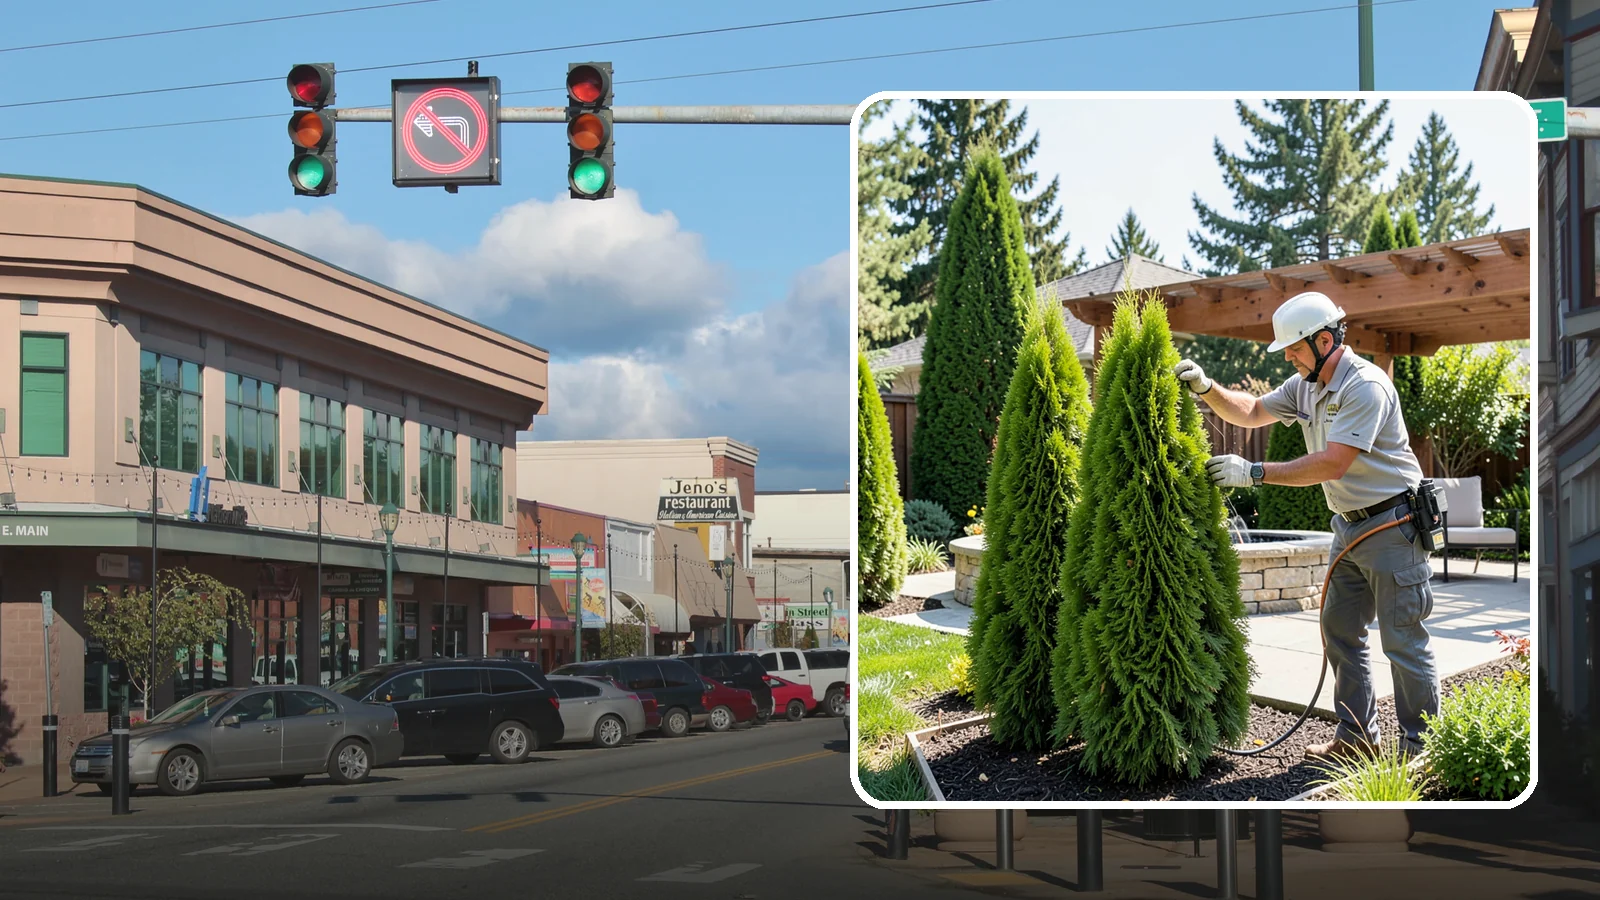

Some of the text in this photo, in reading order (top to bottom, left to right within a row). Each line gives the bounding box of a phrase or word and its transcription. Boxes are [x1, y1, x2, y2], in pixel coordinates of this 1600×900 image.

[669, 480, 728, 495] Jeno's
[665, 496, 731, 509] restaurant
[658, 510, 682, 519] Italian
[686, 510, 715, 519] American
[714, 510, 738, 519] Cuisine
[2, 525, 49, 536] E. MAIN
[797, 608, 828, 617] Street
